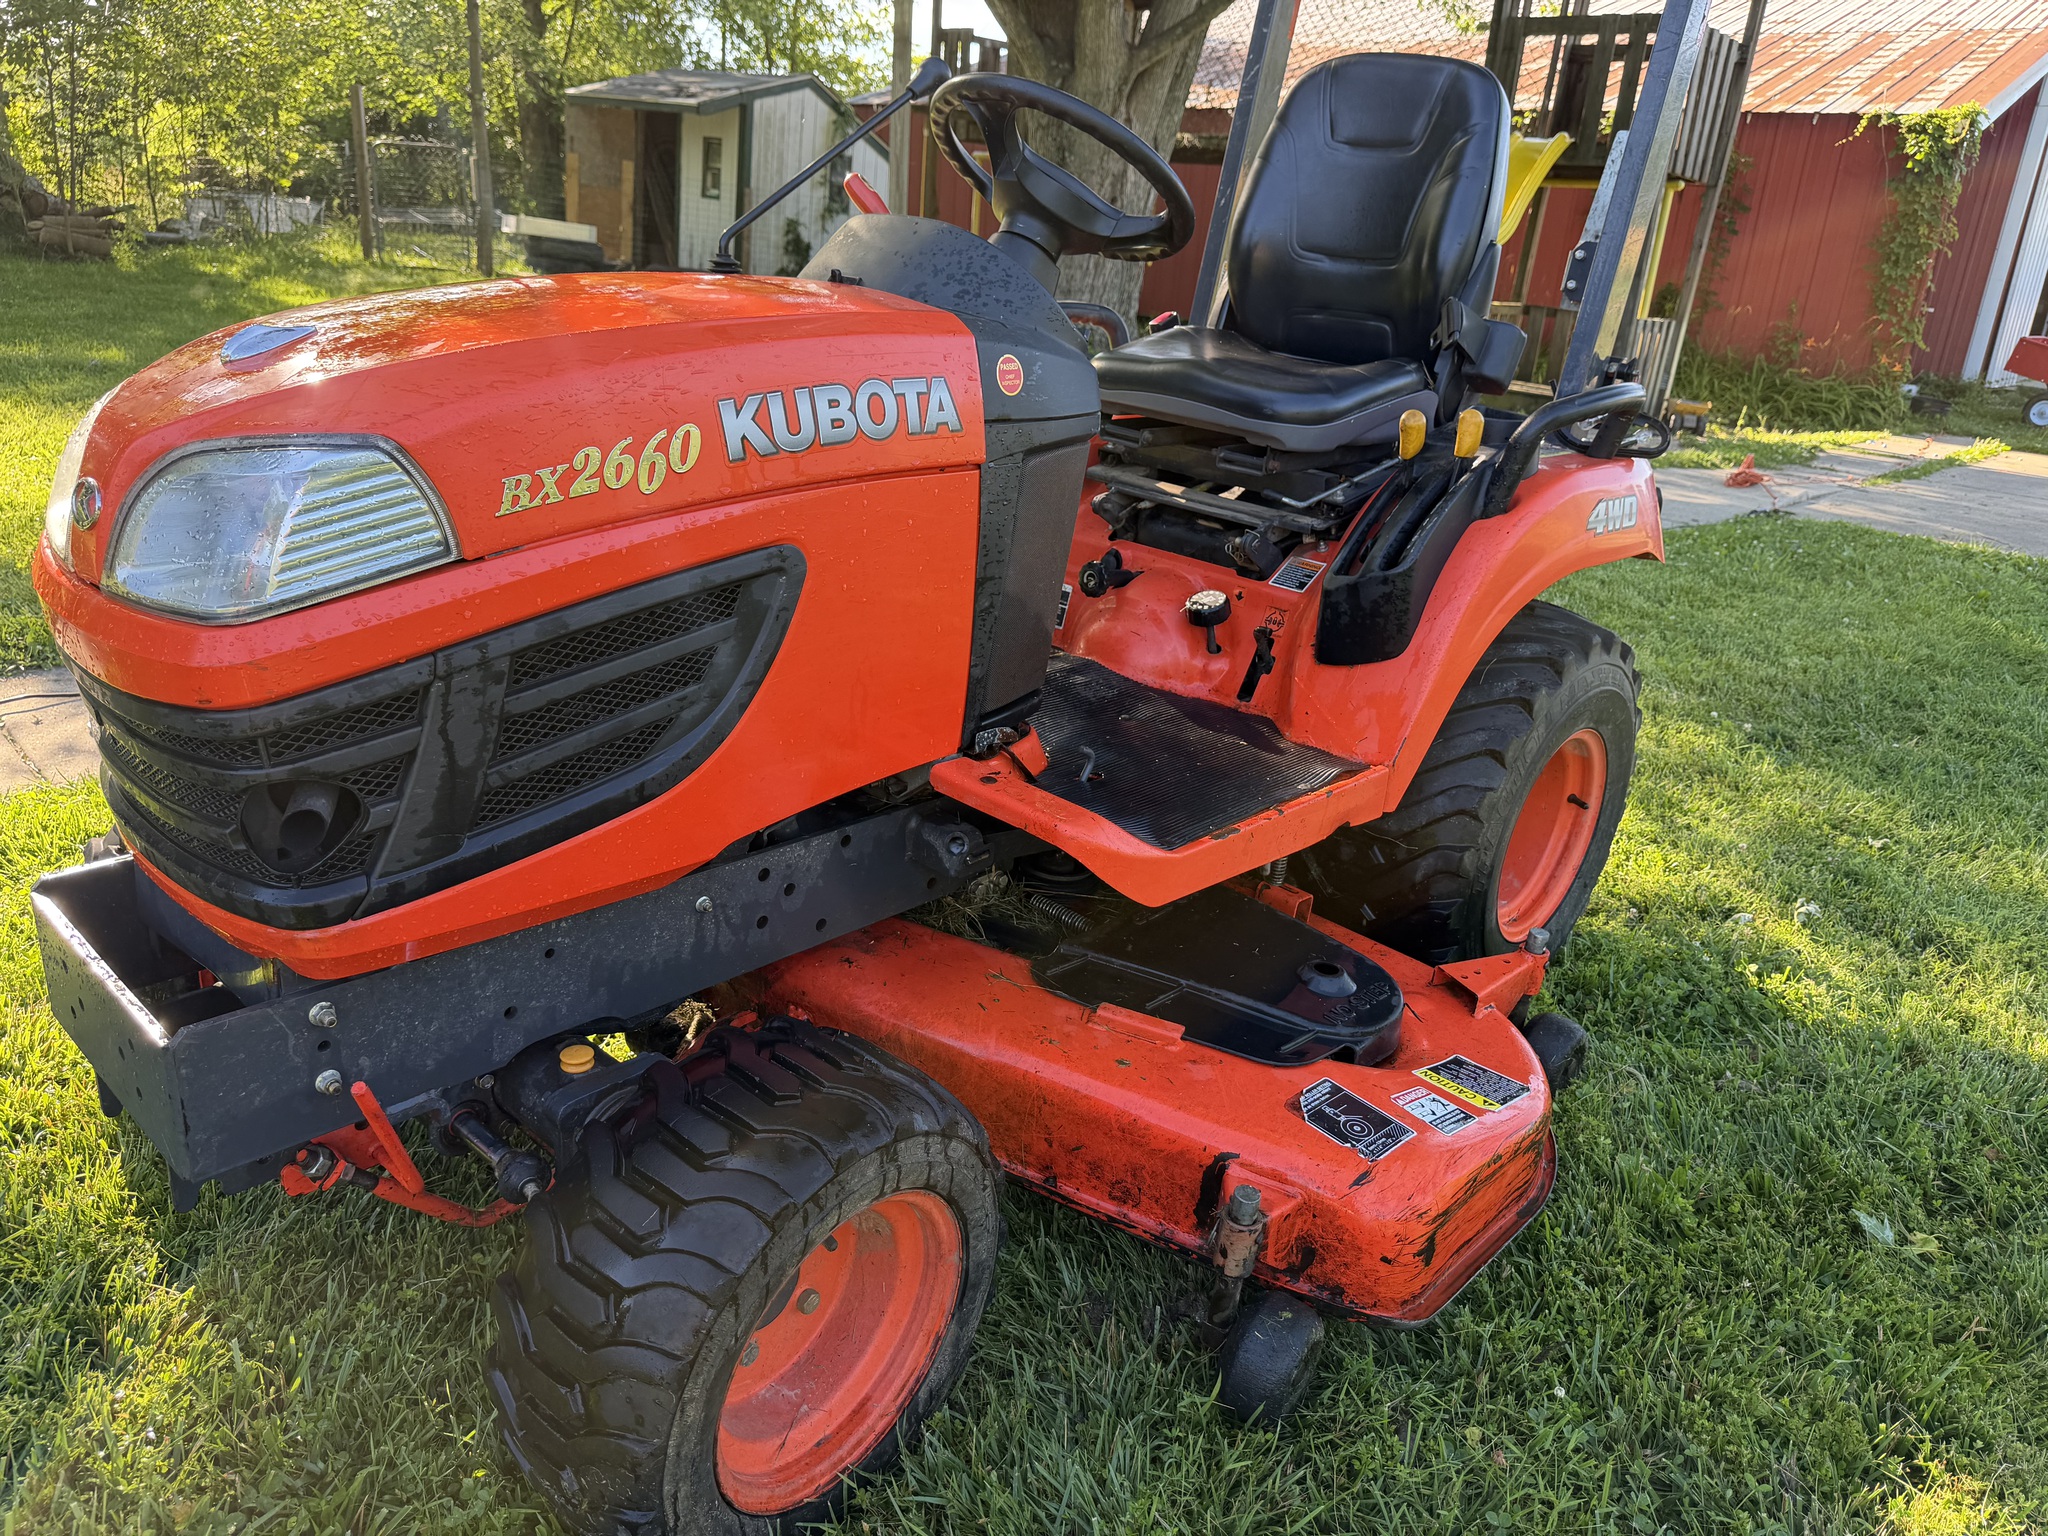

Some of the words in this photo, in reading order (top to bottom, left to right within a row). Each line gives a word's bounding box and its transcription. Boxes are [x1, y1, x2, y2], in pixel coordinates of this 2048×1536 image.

[1000, 362, 1019, 370] PASSED
[717, 377, 963, 462] KUBOTA
[494, 422, 703, 518] BX2660
[1586, 495, 1637, 536] 4WD
[1323, 1004, 1357, 1025] NO
[1349, 982, 1391, 1010] STEP
[1400, 1088, 1430, 1104] DANGER
[1420, 1069, 1477, 1100] CAUTION
